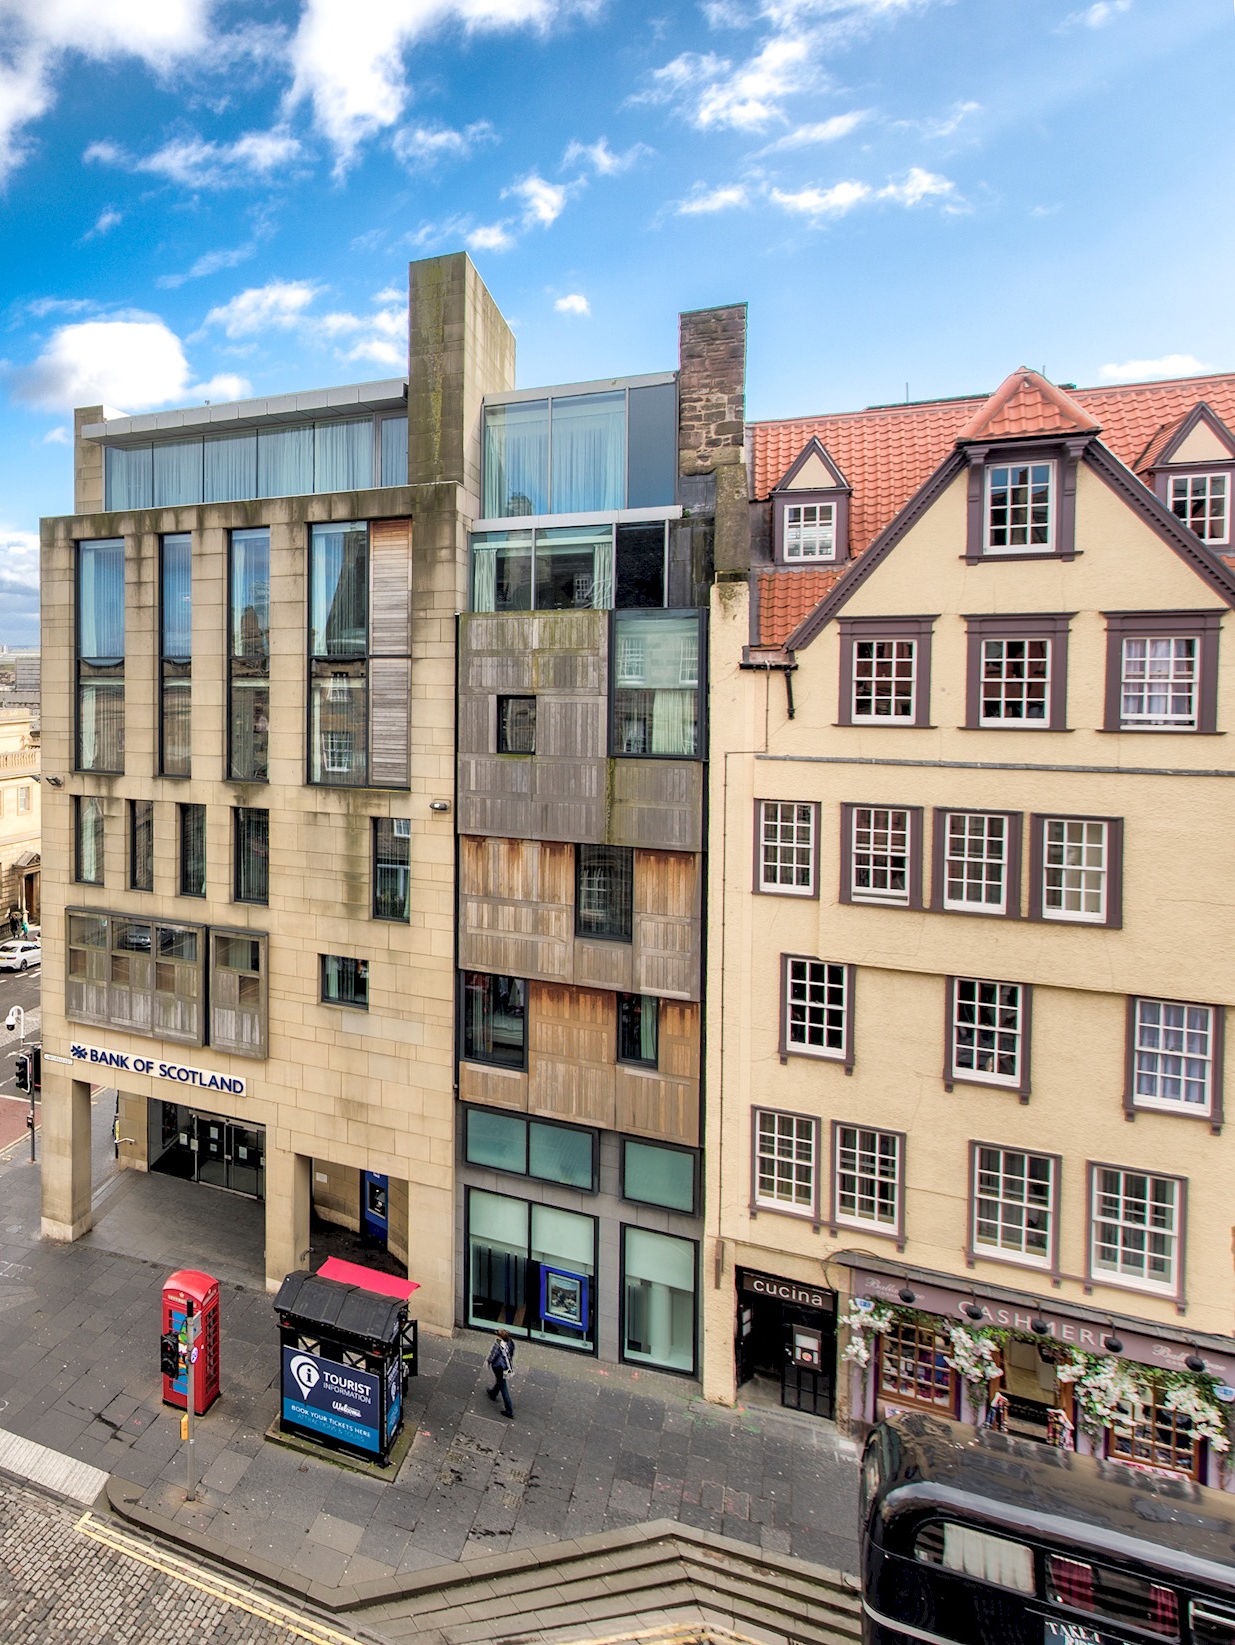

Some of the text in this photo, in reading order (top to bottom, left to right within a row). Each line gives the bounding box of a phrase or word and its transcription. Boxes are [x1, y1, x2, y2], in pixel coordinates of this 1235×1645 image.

[89, 1049, 244, 1094] BANK OF SCOTLAND
[753, 1280, 823, 1306] cucina
[323, 1371, 372, 1396] TOURIST
[323, 1382, 372, 1405] INFORMATION
[291, 1404, 372, 1438] BOOK YOUR TICKETS HERE
[1045, 1621, 1090, 1641] TAKE
